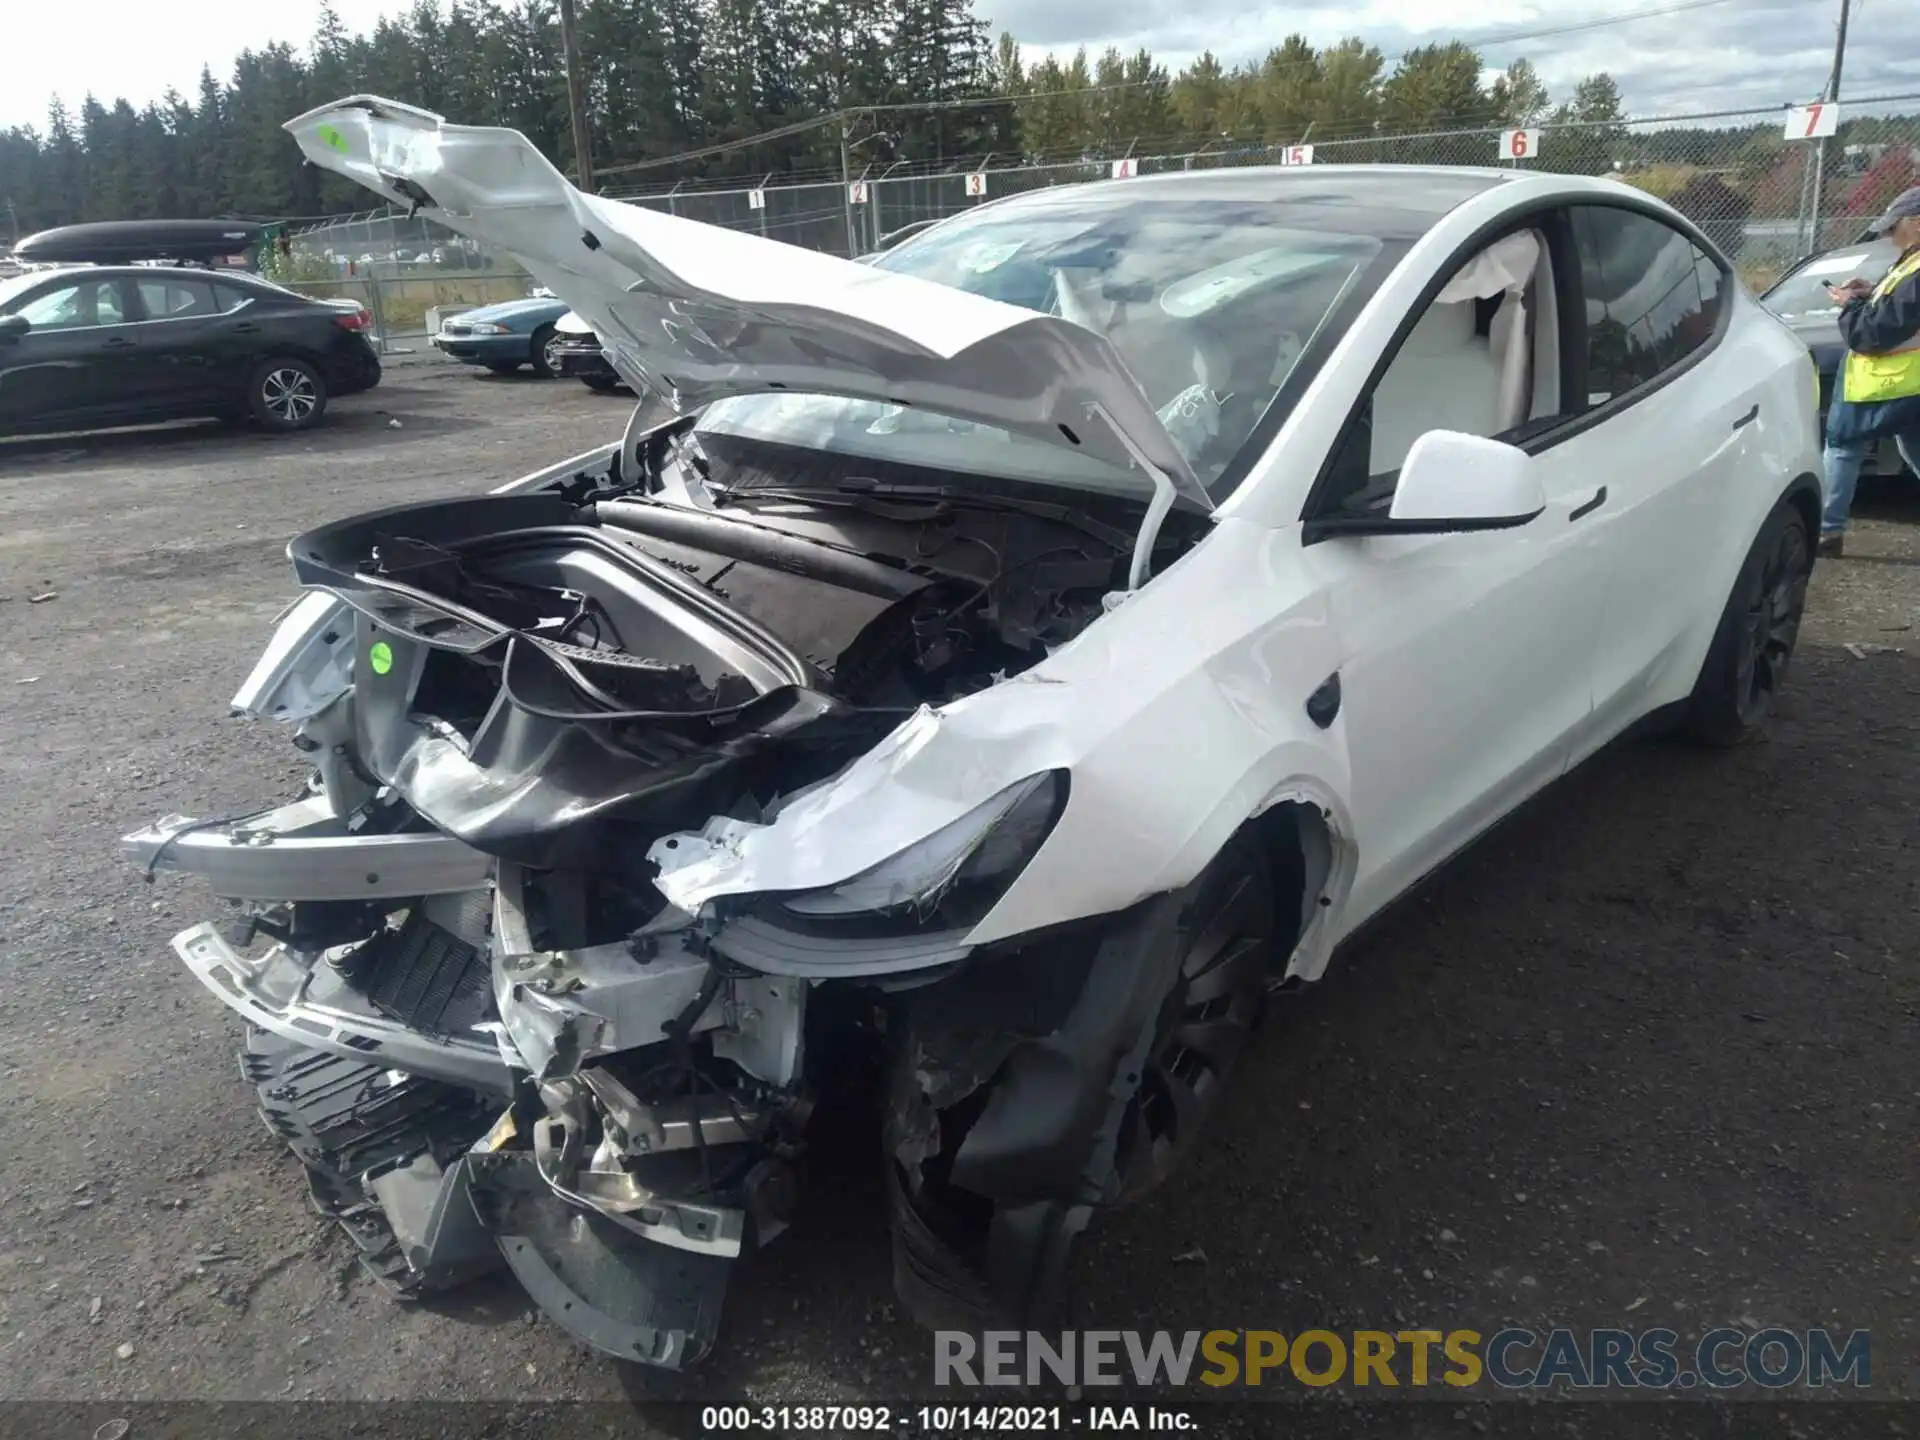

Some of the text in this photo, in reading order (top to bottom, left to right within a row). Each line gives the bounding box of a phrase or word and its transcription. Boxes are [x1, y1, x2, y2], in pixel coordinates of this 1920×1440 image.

[1804, 104, 1822, 137] 7
[1511, 131, 1527, 157] 6
[1291, 147, 1304, 165] 5
[1118, 159, 1129, 179] 4
[855, 184, 863, 201] 2
[971, 175, 981, 194] 3
